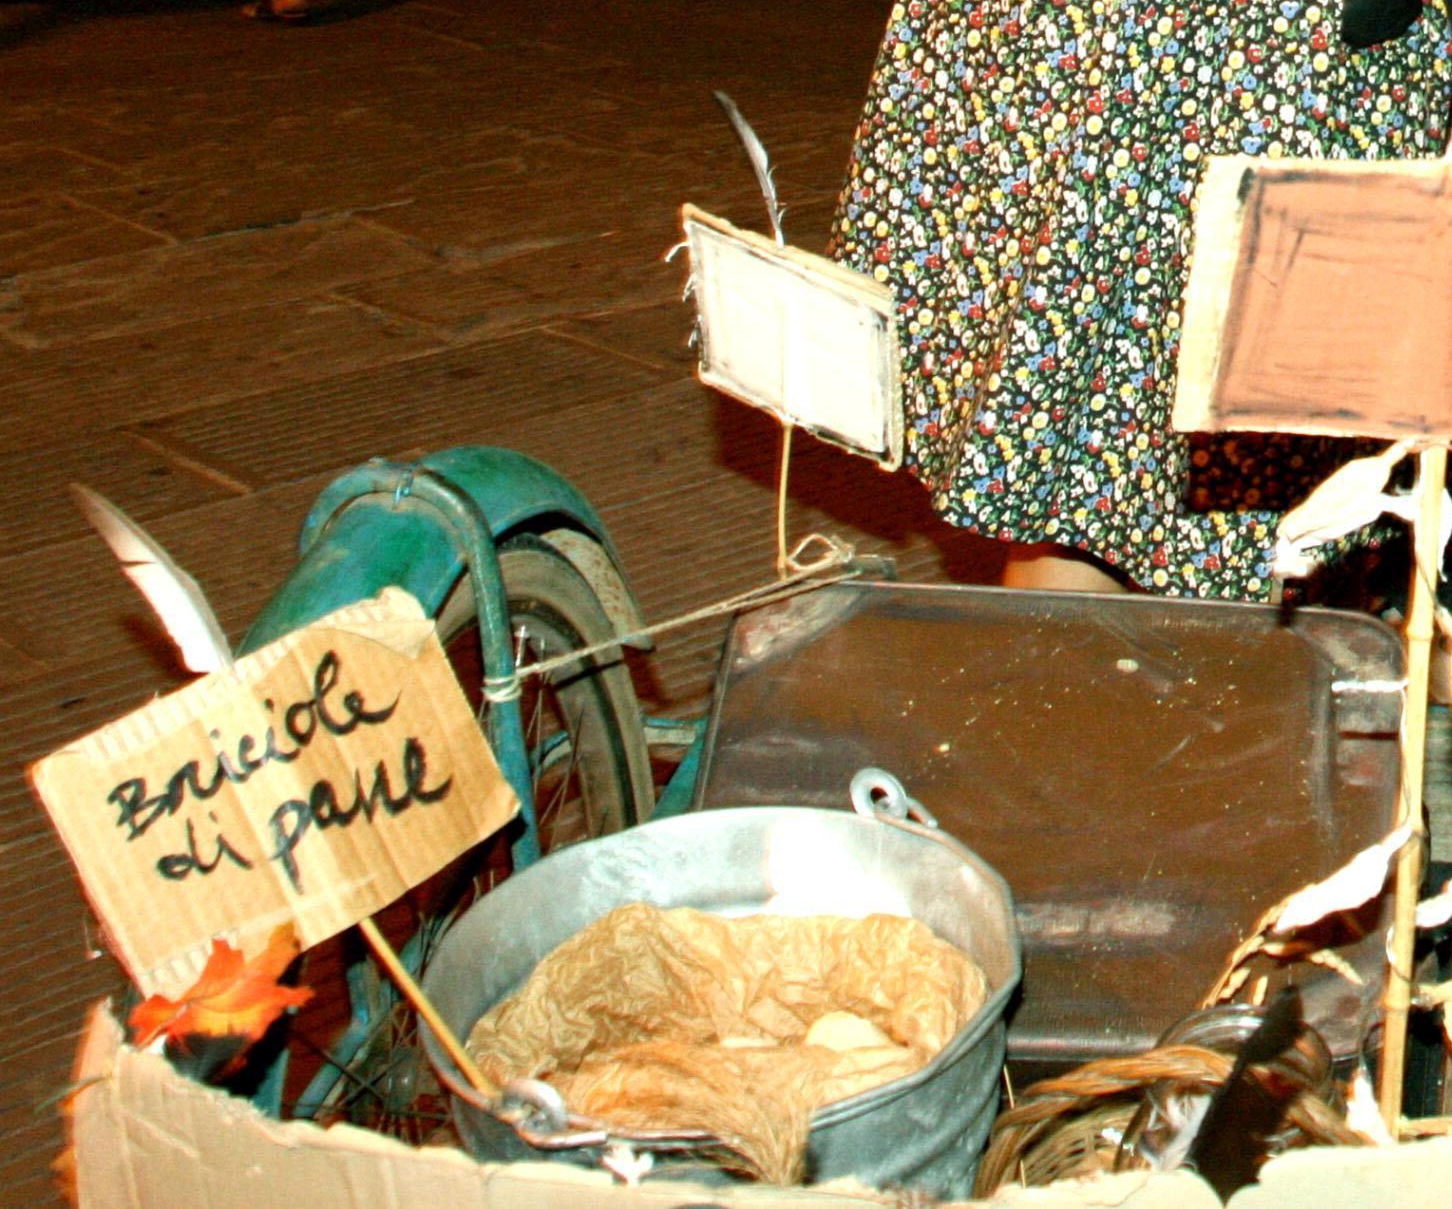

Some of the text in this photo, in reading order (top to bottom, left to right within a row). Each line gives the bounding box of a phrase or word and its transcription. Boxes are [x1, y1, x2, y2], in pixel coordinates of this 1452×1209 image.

[107, 650, 401, 841] Briciole
[155, 736, 453, 894] di pane
